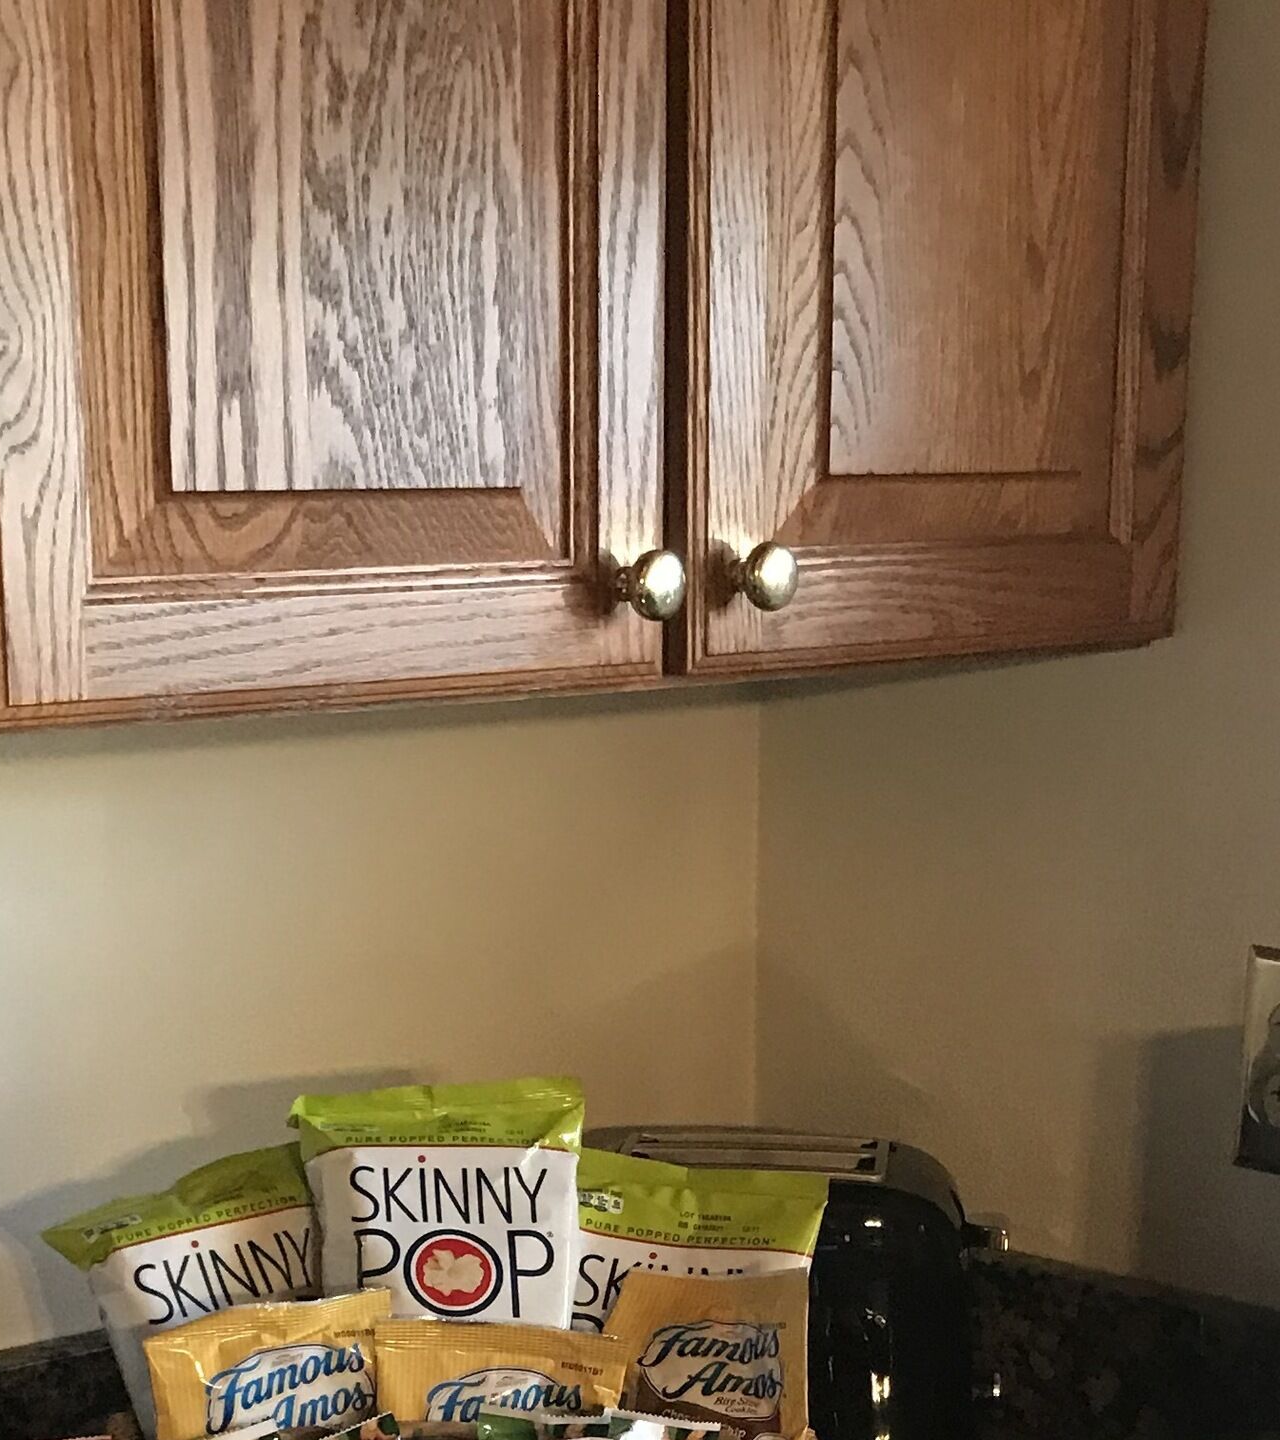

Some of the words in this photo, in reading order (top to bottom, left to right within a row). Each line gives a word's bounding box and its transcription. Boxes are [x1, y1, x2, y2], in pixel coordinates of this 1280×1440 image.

[345, 1136, 383, 1144] PURE
[389, 1134, 446, 1143] POPPED
[349, 1155, 548, 1224] SKINNY
[585, 1218, 620, 1233] PURE
[627, 1226, 681, 1243] POPPED
[133, 1227, 313, 1325] SKINNY
[353, 1229, 555, 1318] POP
[636, 1324, 780, 1368] Famous
[206, 1343, 365, 1434] Famous
[661, 1361, 784, 1400] Amos
